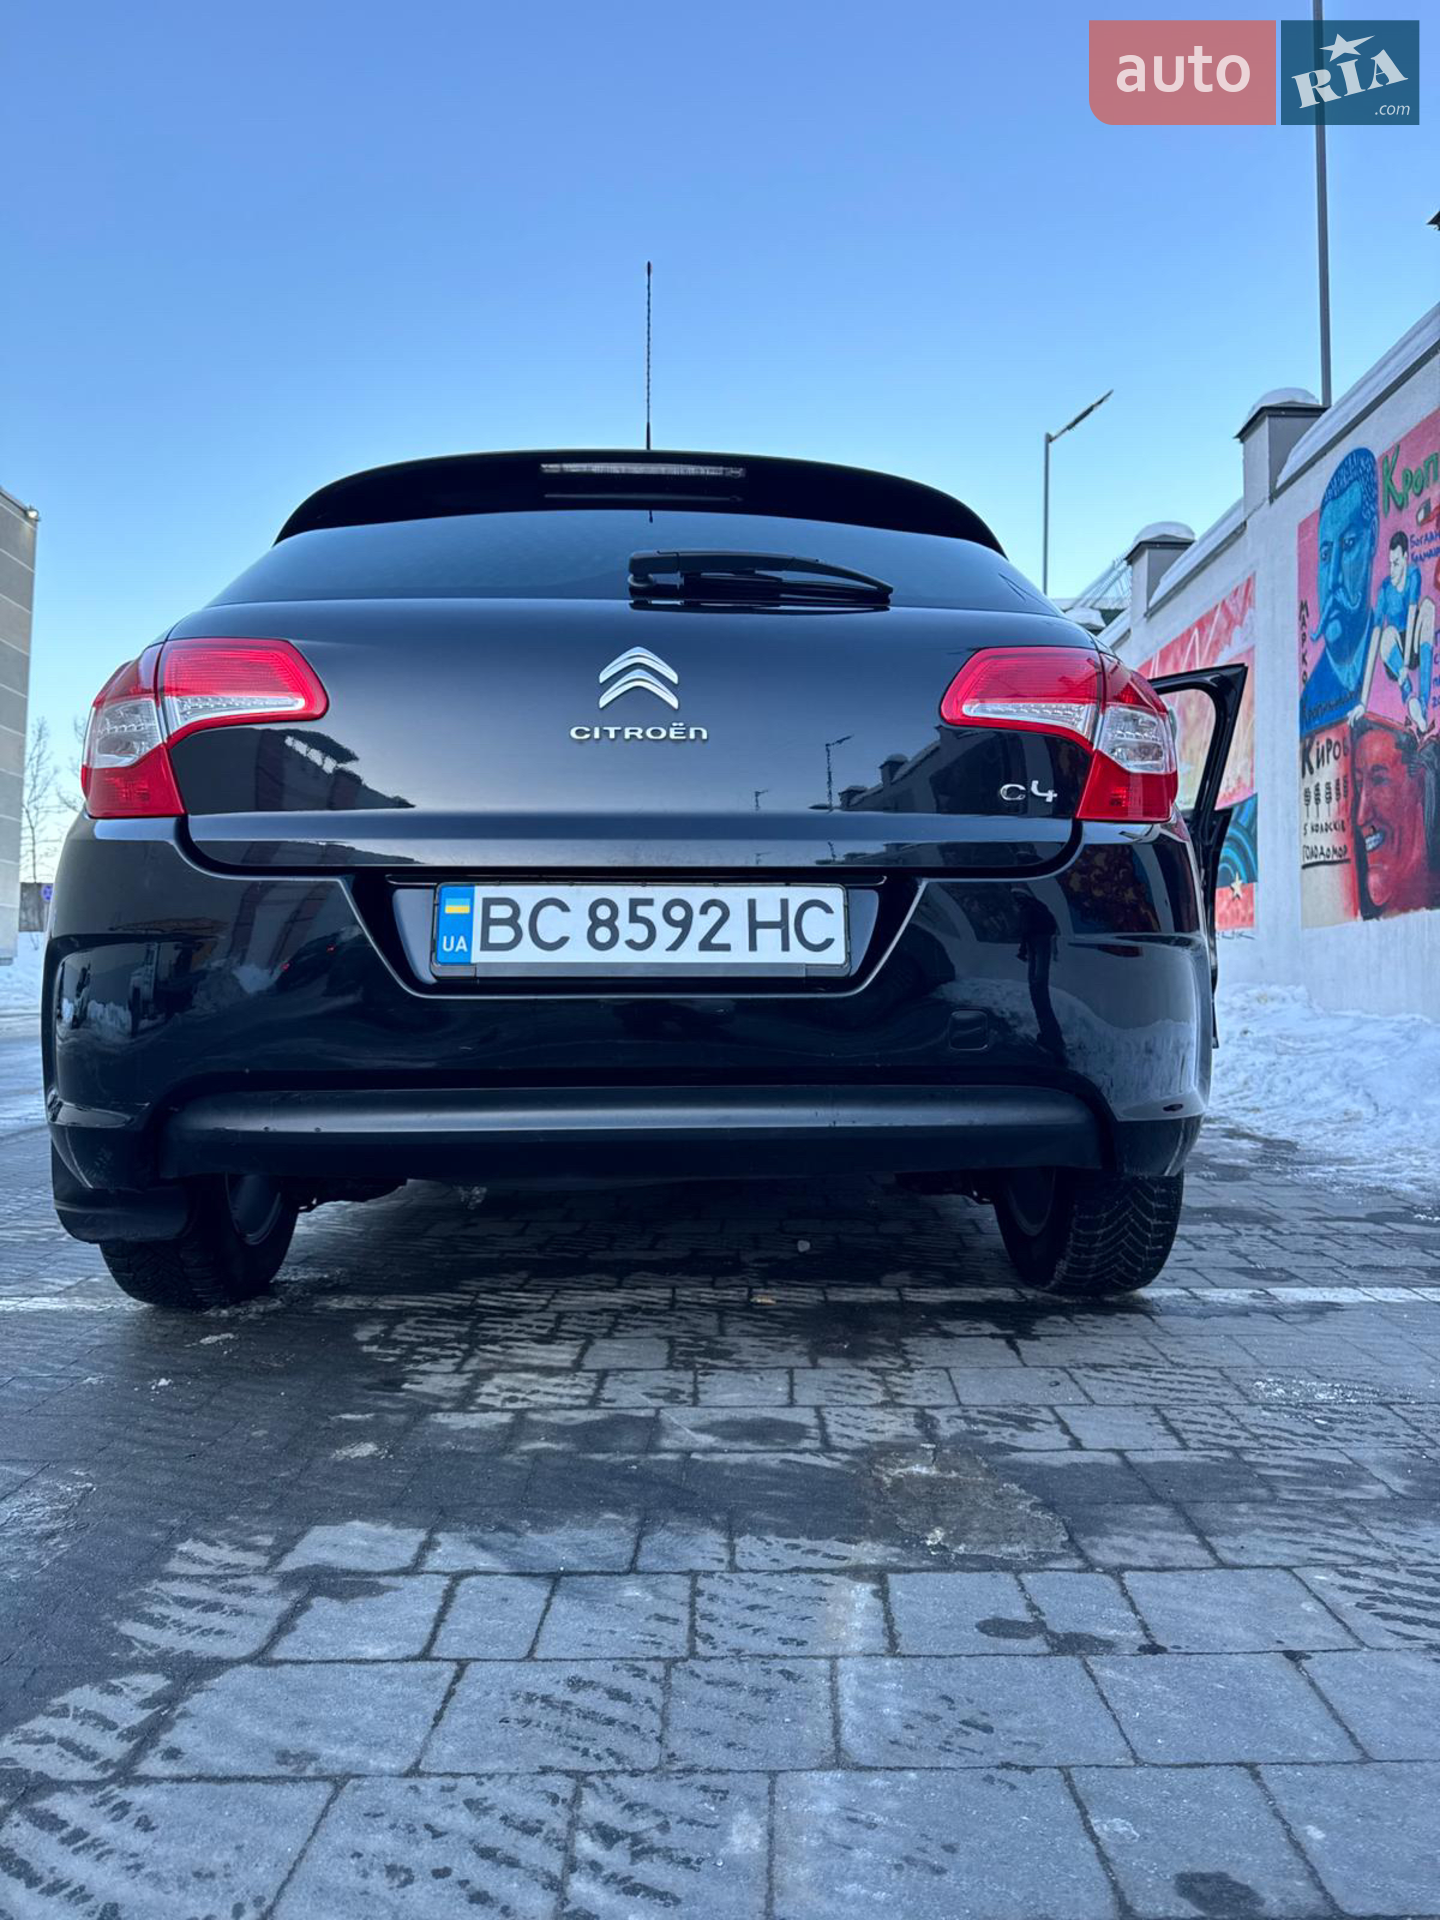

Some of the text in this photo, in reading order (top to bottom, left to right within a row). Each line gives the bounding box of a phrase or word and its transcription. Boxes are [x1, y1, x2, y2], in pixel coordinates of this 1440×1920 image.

[1000, 780, 1058, 803] C4
[479, 897, 836, 952] BC 8592 HC
[442, 935, 469, 953] UA
